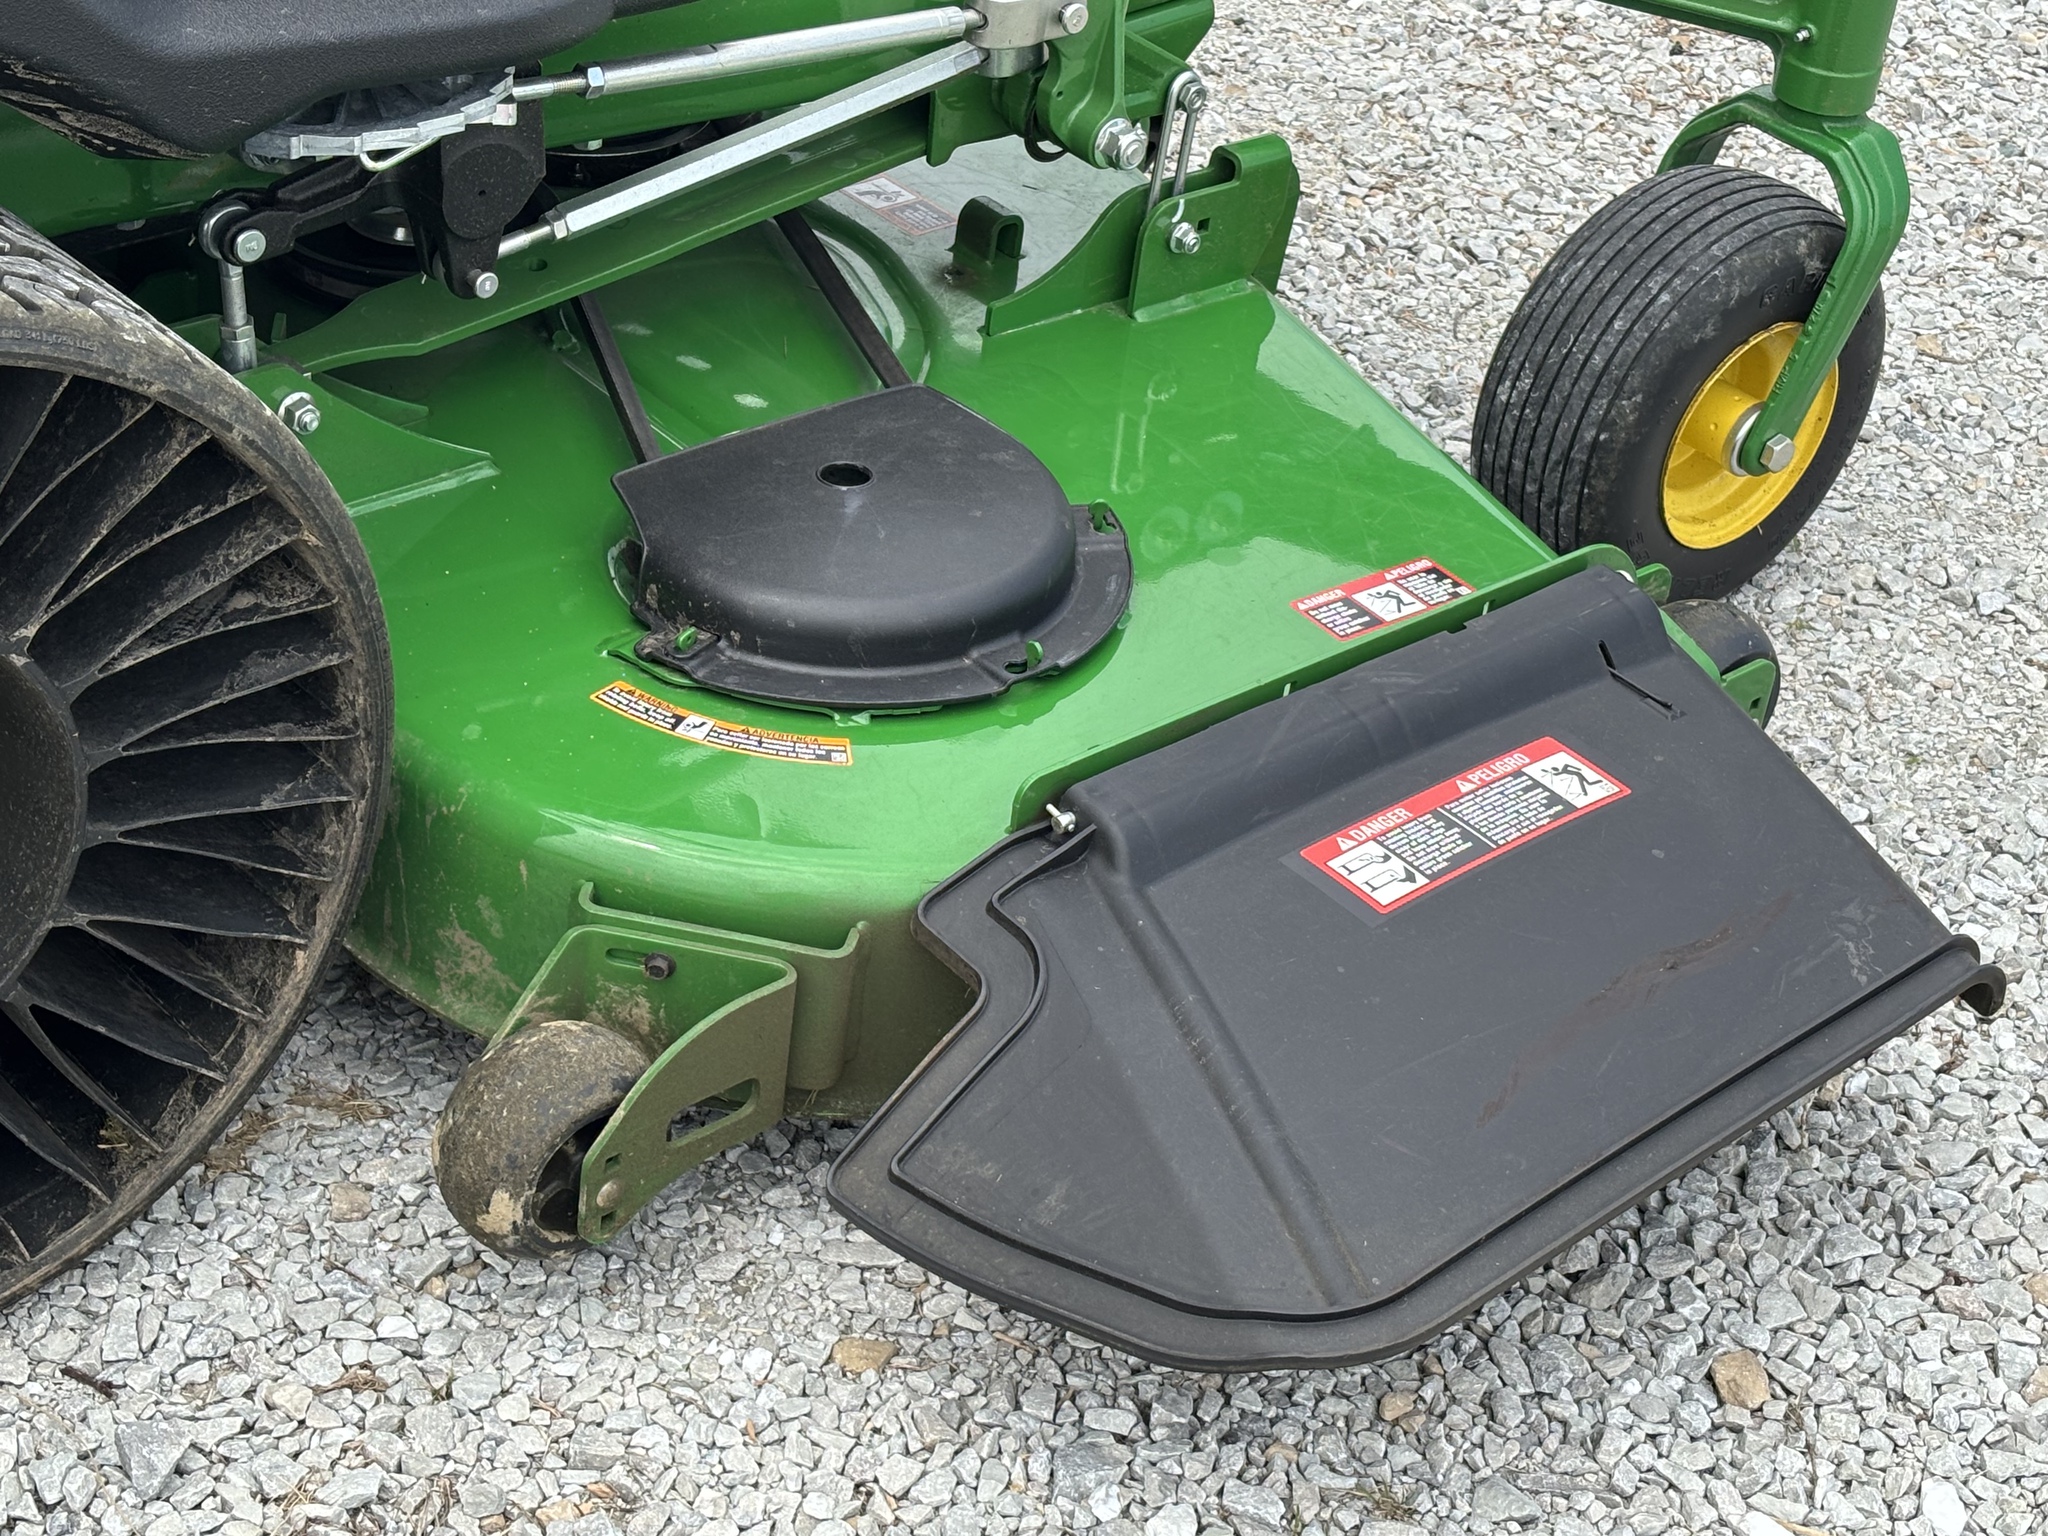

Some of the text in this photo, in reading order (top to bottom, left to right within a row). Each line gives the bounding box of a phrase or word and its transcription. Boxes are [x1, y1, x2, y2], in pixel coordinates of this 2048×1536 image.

[1306, 559, 1433, 607] DANGER PELIGRO
[752, 729, 819, 743] ADVERTENCIA
[1348, 752, 1531, 842] DANGER PELIGRO
